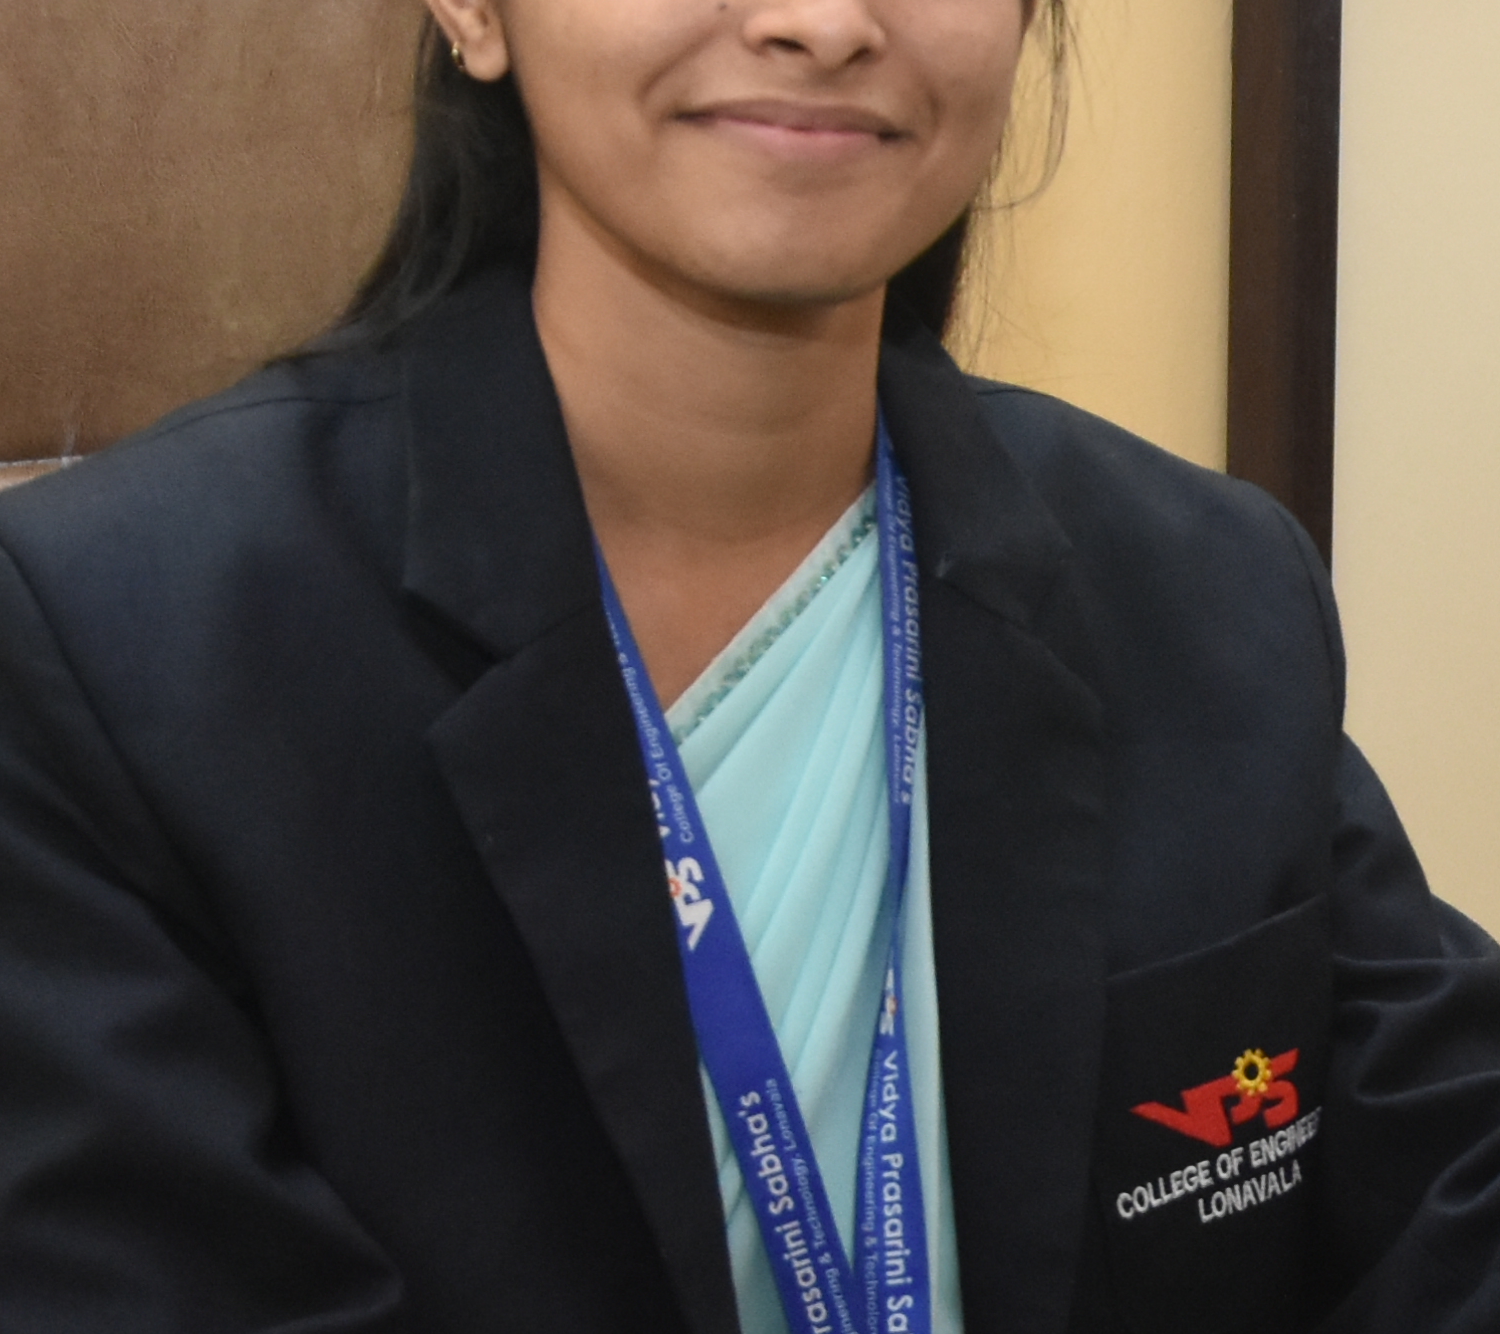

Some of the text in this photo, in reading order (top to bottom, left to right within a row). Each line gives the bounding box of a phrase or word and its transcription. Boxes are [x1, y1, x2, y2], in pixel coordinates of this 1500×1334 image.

[621, 667, 665, 758] Engineering
[656, 762, 673, 781] Of
[666, 784, 695, 843] College
[765, 1078, 798, 1152] Lonavala
[878, 1050, 900, 1143] Vidya
[737, 1091, 795, 1216] Sabha's
[1116, 1105, 1322, 1220] COLLEGE OF ENGINEE
[1198, 1159, 1303, 1223] LONAVALA
[817, 1252, 833, 1265] &
[881, 1153, 913, 1286] Prasarini
